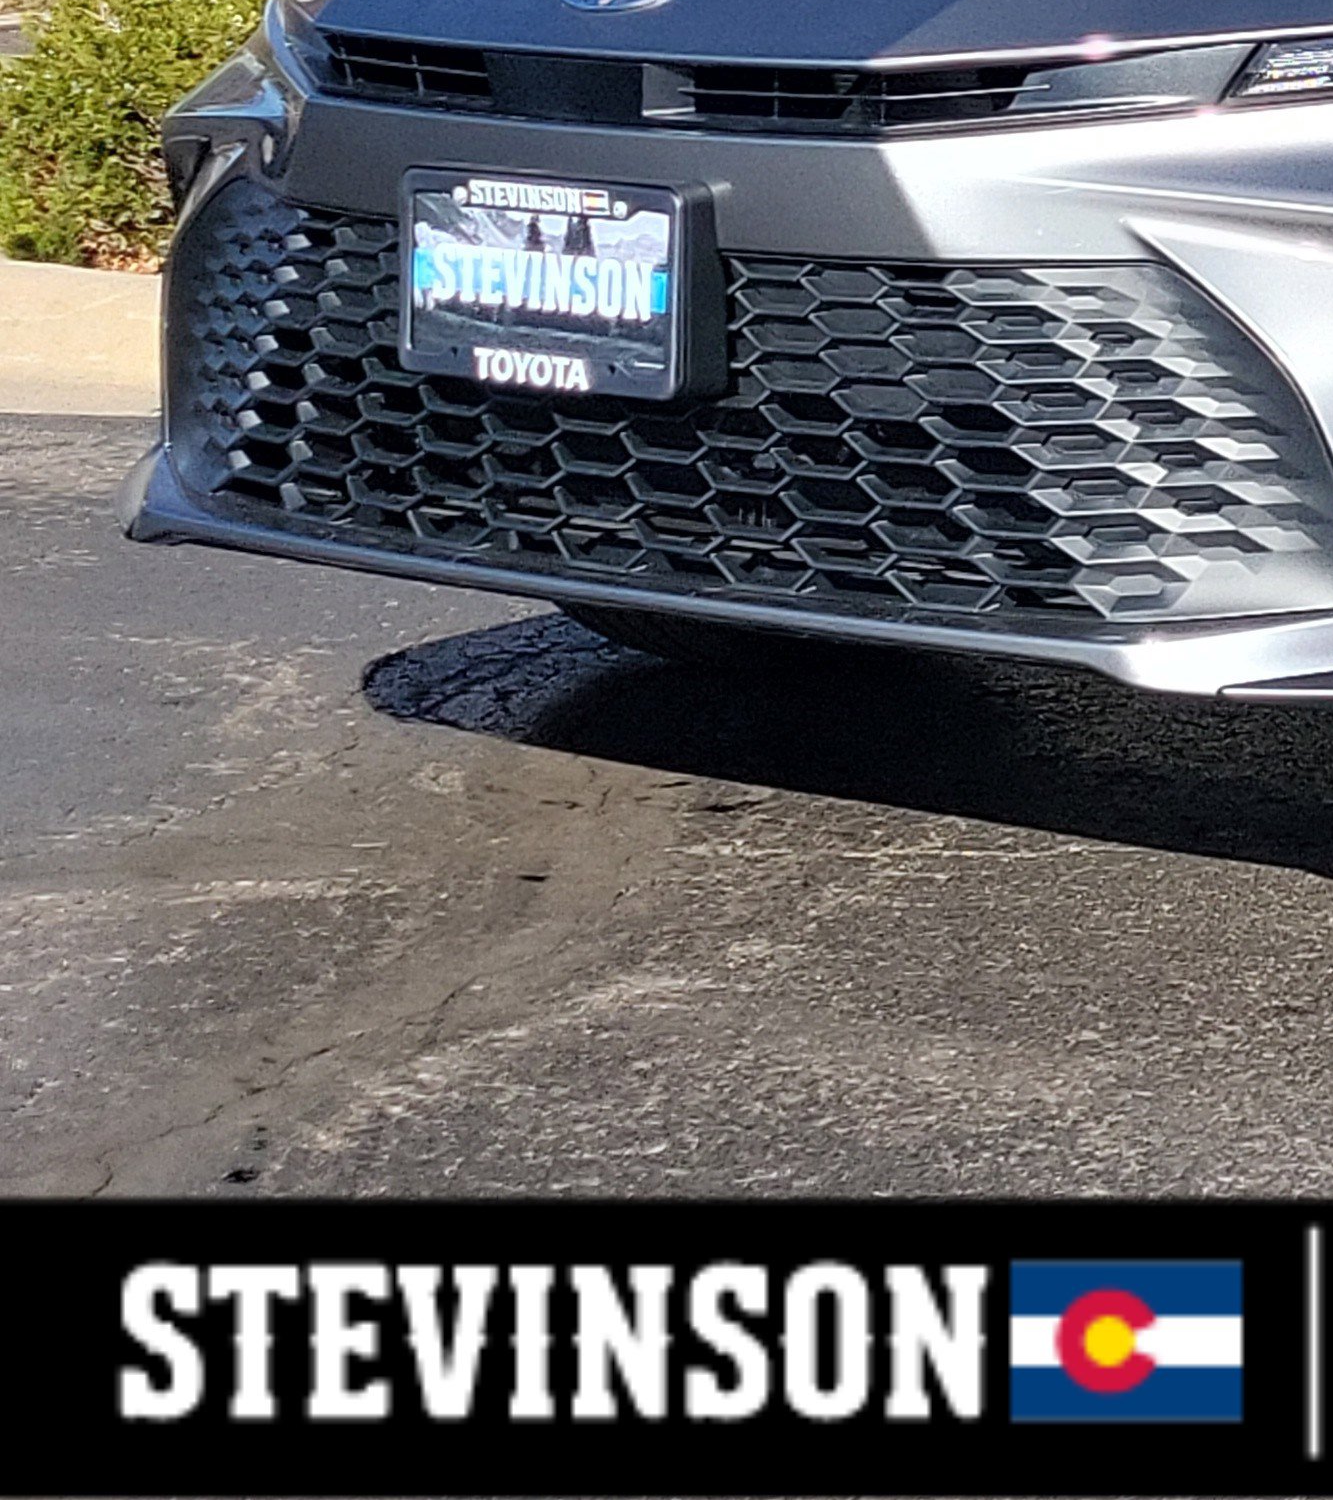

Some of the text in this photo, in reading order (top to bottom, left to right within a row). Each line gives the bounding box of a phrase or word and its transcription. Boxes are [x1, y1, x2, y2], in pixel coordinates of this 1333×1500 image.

[468, 179, 583, 214] STEVINSON
[432, 243, 653, 322] STEVINSON
[473, 347, 591, 391] TOYOTA
